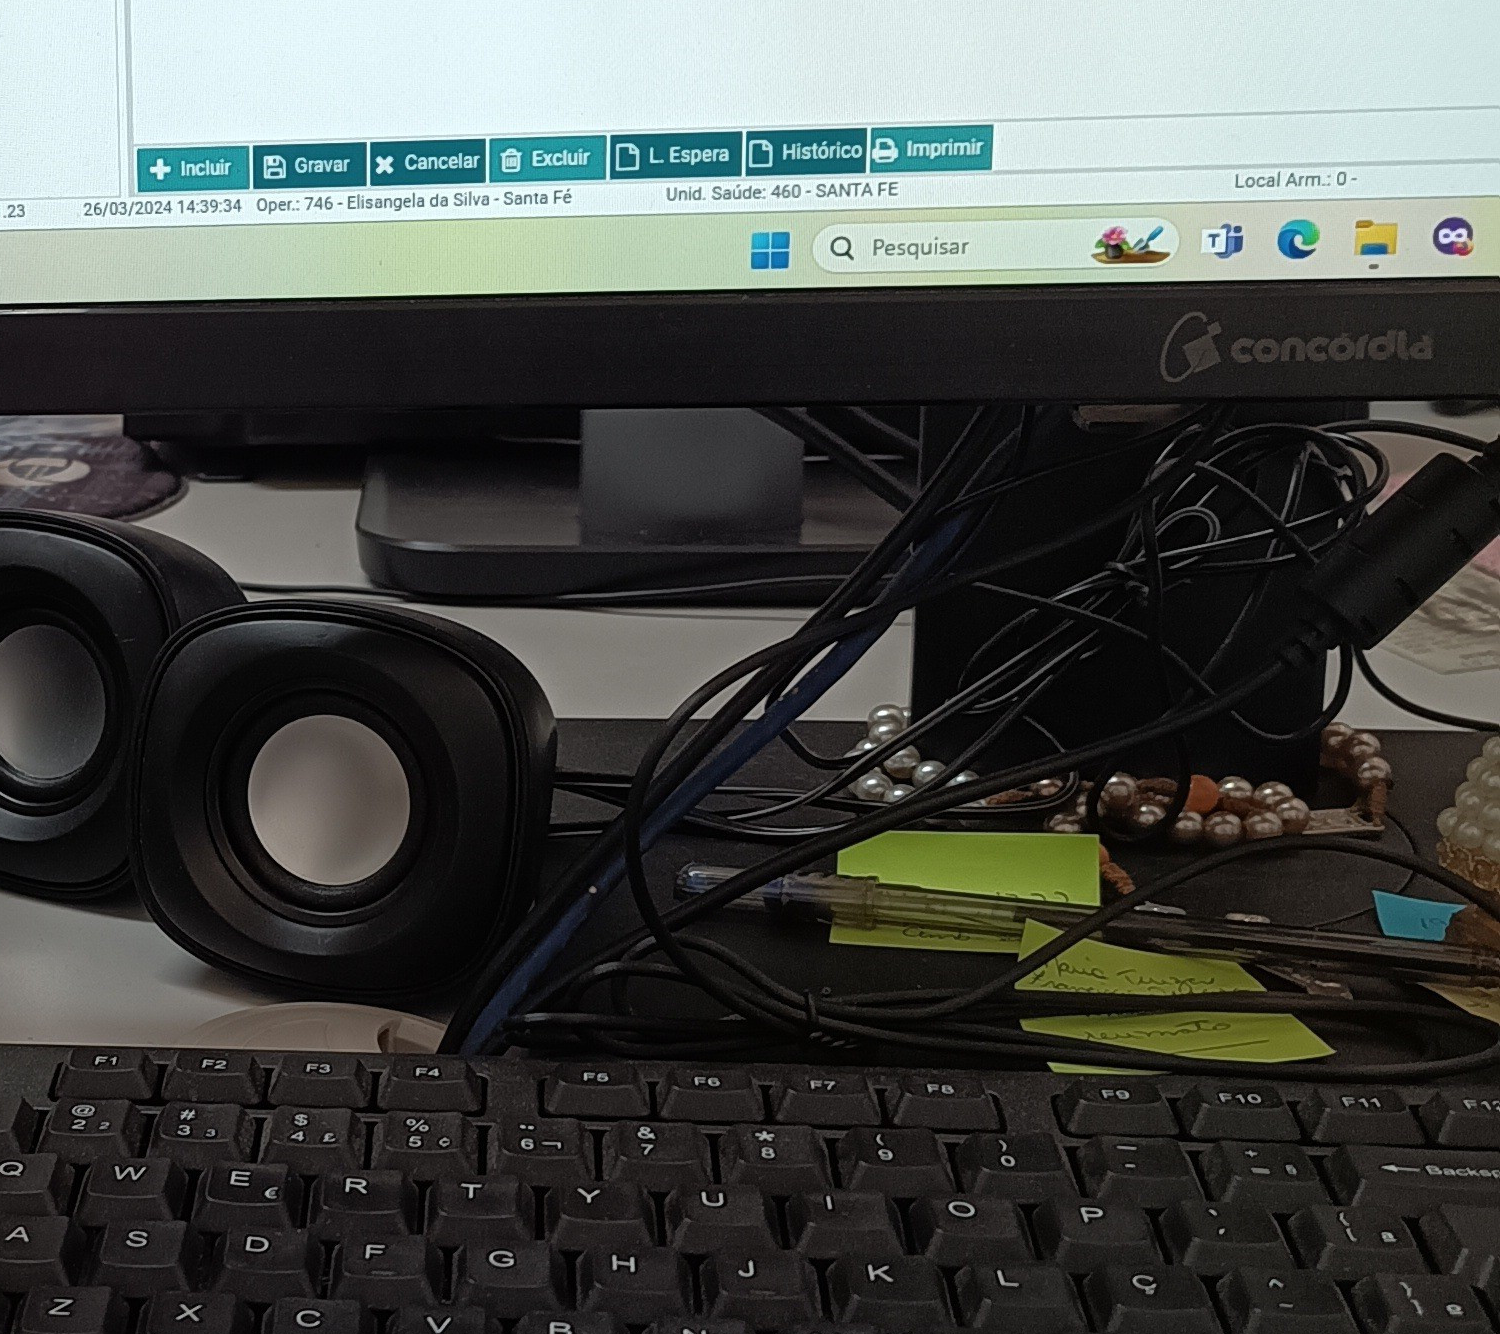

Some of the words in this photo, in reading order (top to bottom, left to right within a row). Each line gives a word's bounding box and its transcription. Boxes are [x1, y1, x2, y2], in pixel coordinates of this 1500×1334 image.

[532, 148, 591, 167] Excluir
[783, 141, 863, 161] Histórico
[906, 139, 985, 160] Imprimir
[181, 157, 231, 179] Incluir
[294, 155, 351, 176] Gravar
[404, 151, 480, 171] Cancelar
[83, 197, 173, 218] 26/03/2024
[177, 196, 242, 216] 14:39:34
[872, 237, 969, 263] Pesquisar
[200, 1057, 228, 1072] F2
[1217, 1091, 1263, 1107] F10
[112, 1165, 147, 1182] W
[4, 1225, 31, 1245] A
[174, 1304, 203, 1323] X
